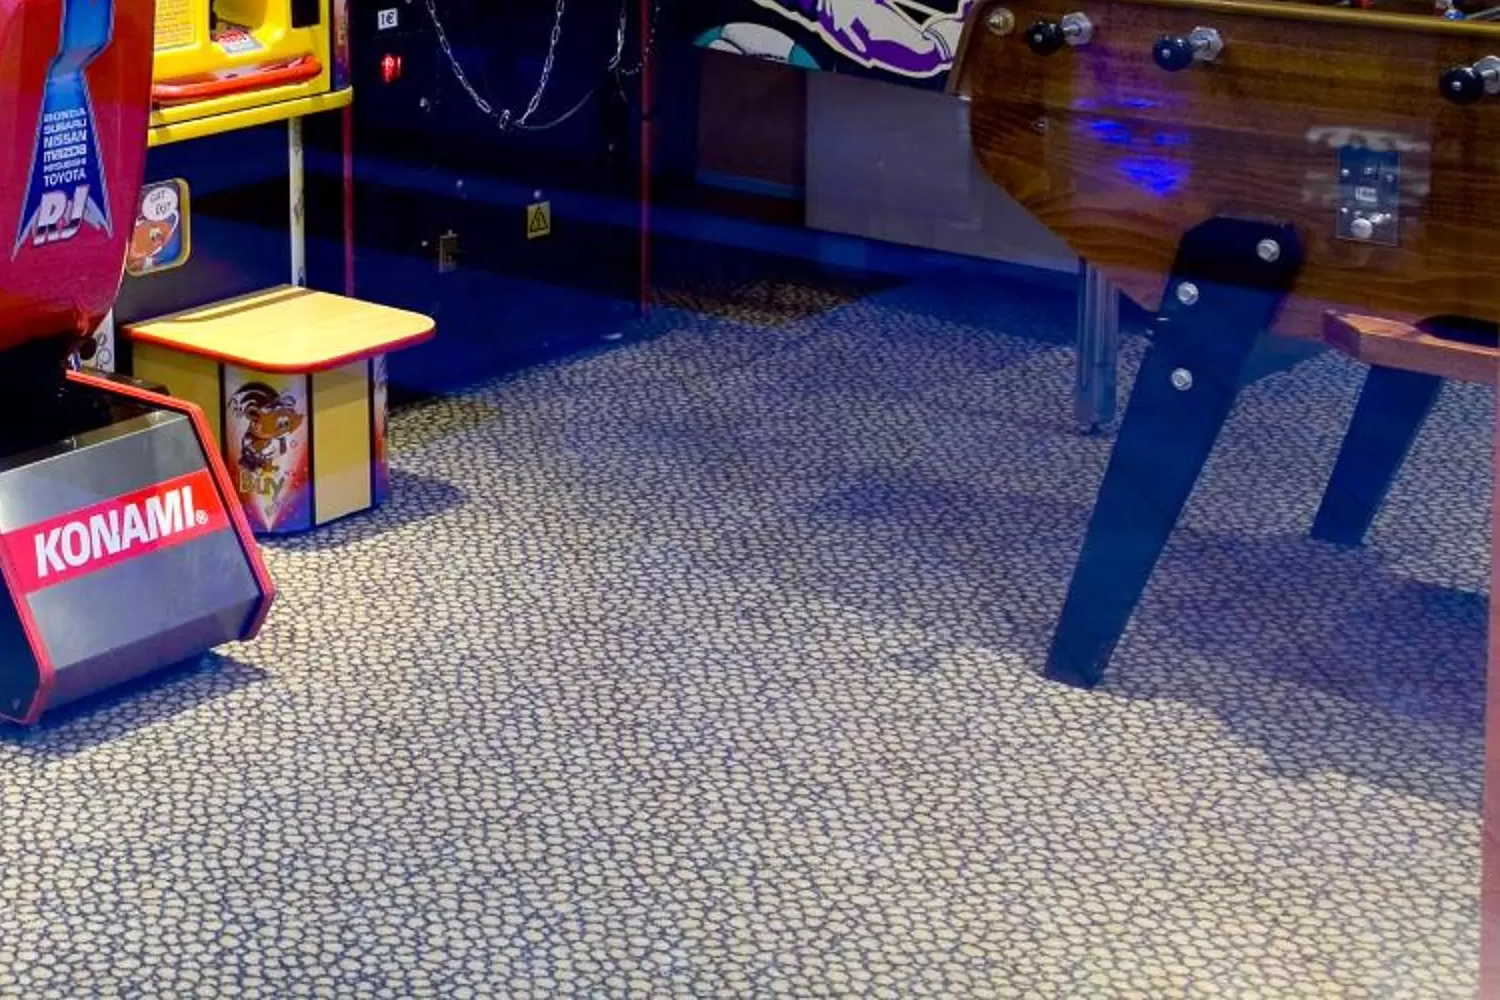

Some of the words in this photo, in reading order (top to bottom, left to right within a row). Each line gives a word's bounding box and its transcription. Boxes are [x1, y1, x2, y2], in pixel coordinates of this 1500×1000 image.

[380, 11, 395, 26] 1€
[43, 129, 87, 149] NISSAN
[43, 167, 87, 188] TOYOTA
